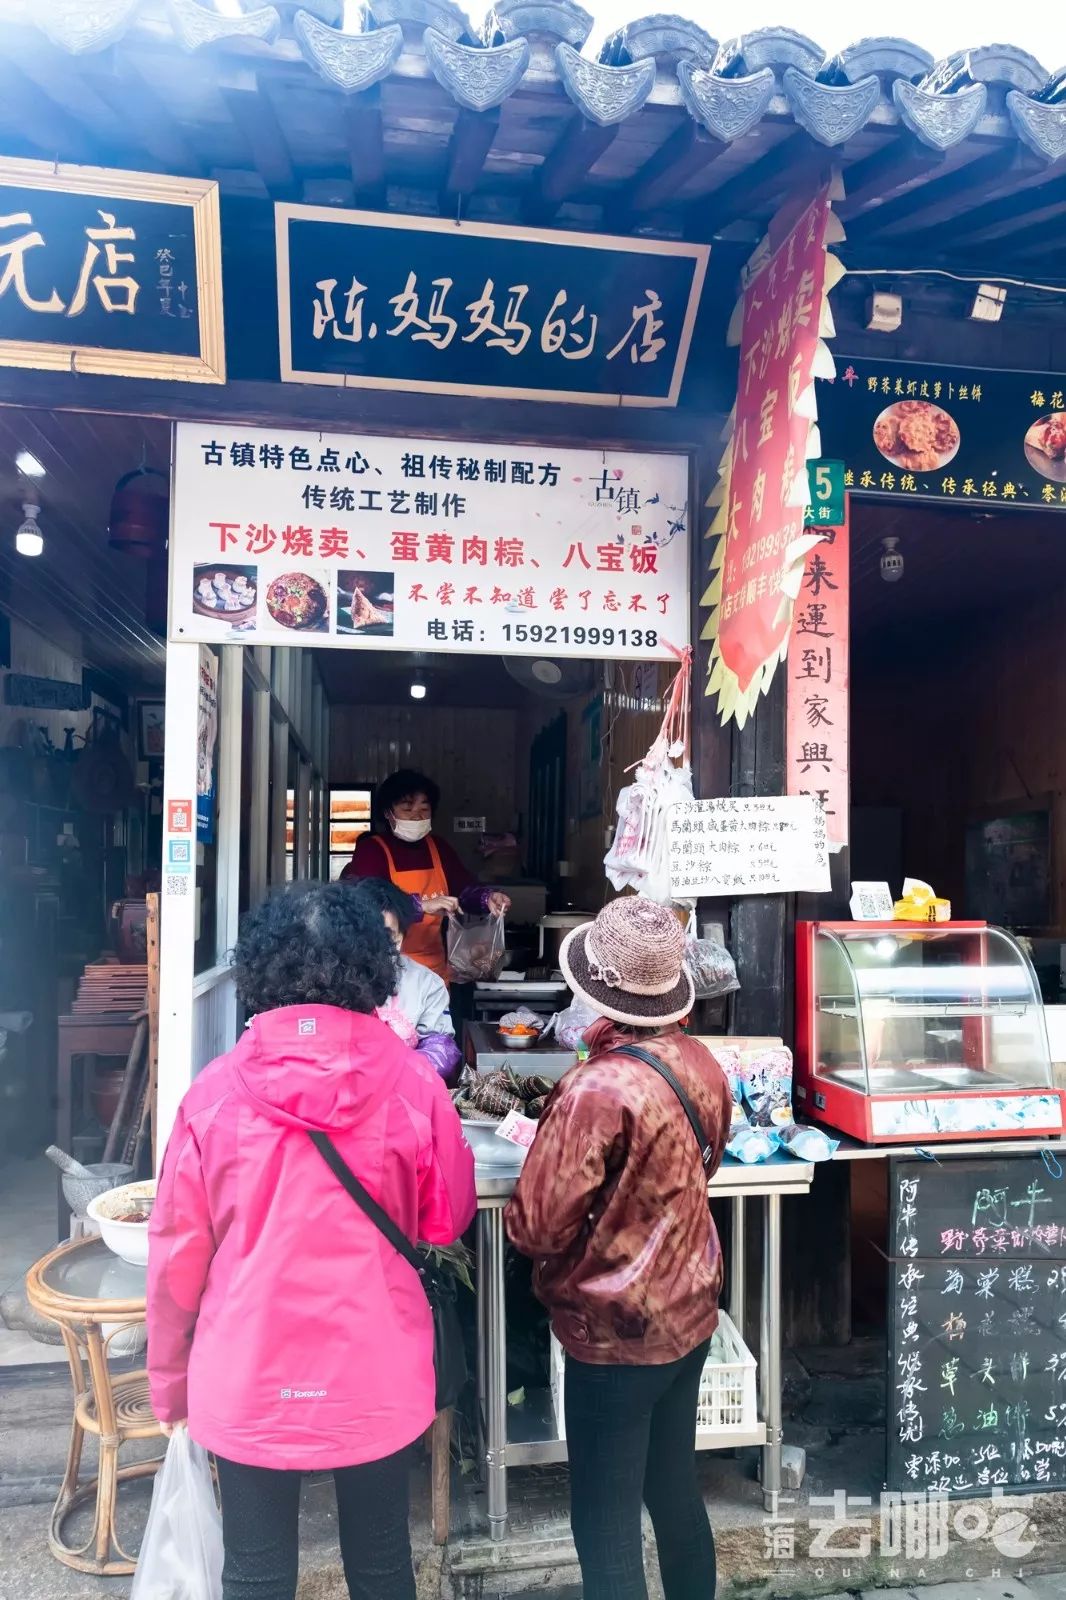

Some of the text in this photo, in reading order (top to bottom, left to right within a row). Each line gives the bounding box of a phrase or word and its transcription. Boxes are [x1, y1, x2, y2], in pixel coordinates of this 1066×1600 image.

[313, 270, 667, 364] 陈妈妈的店
[867, 376, 983, 402] 野荠菜虾皮萝卜丝饼
[201, 441, 561, 486] 古镇特色点心、祖传秘制配方
[302, 484, 466, 517] 传统工艺制作
[589, 469, 641, 514] 古镇
[815, 467, 832, 500] 5
[208, 522, 659, 574] 下沙烧卖、蛋黄肉粽、八宝饭
[502, 624, 658, 647] 15921999138
